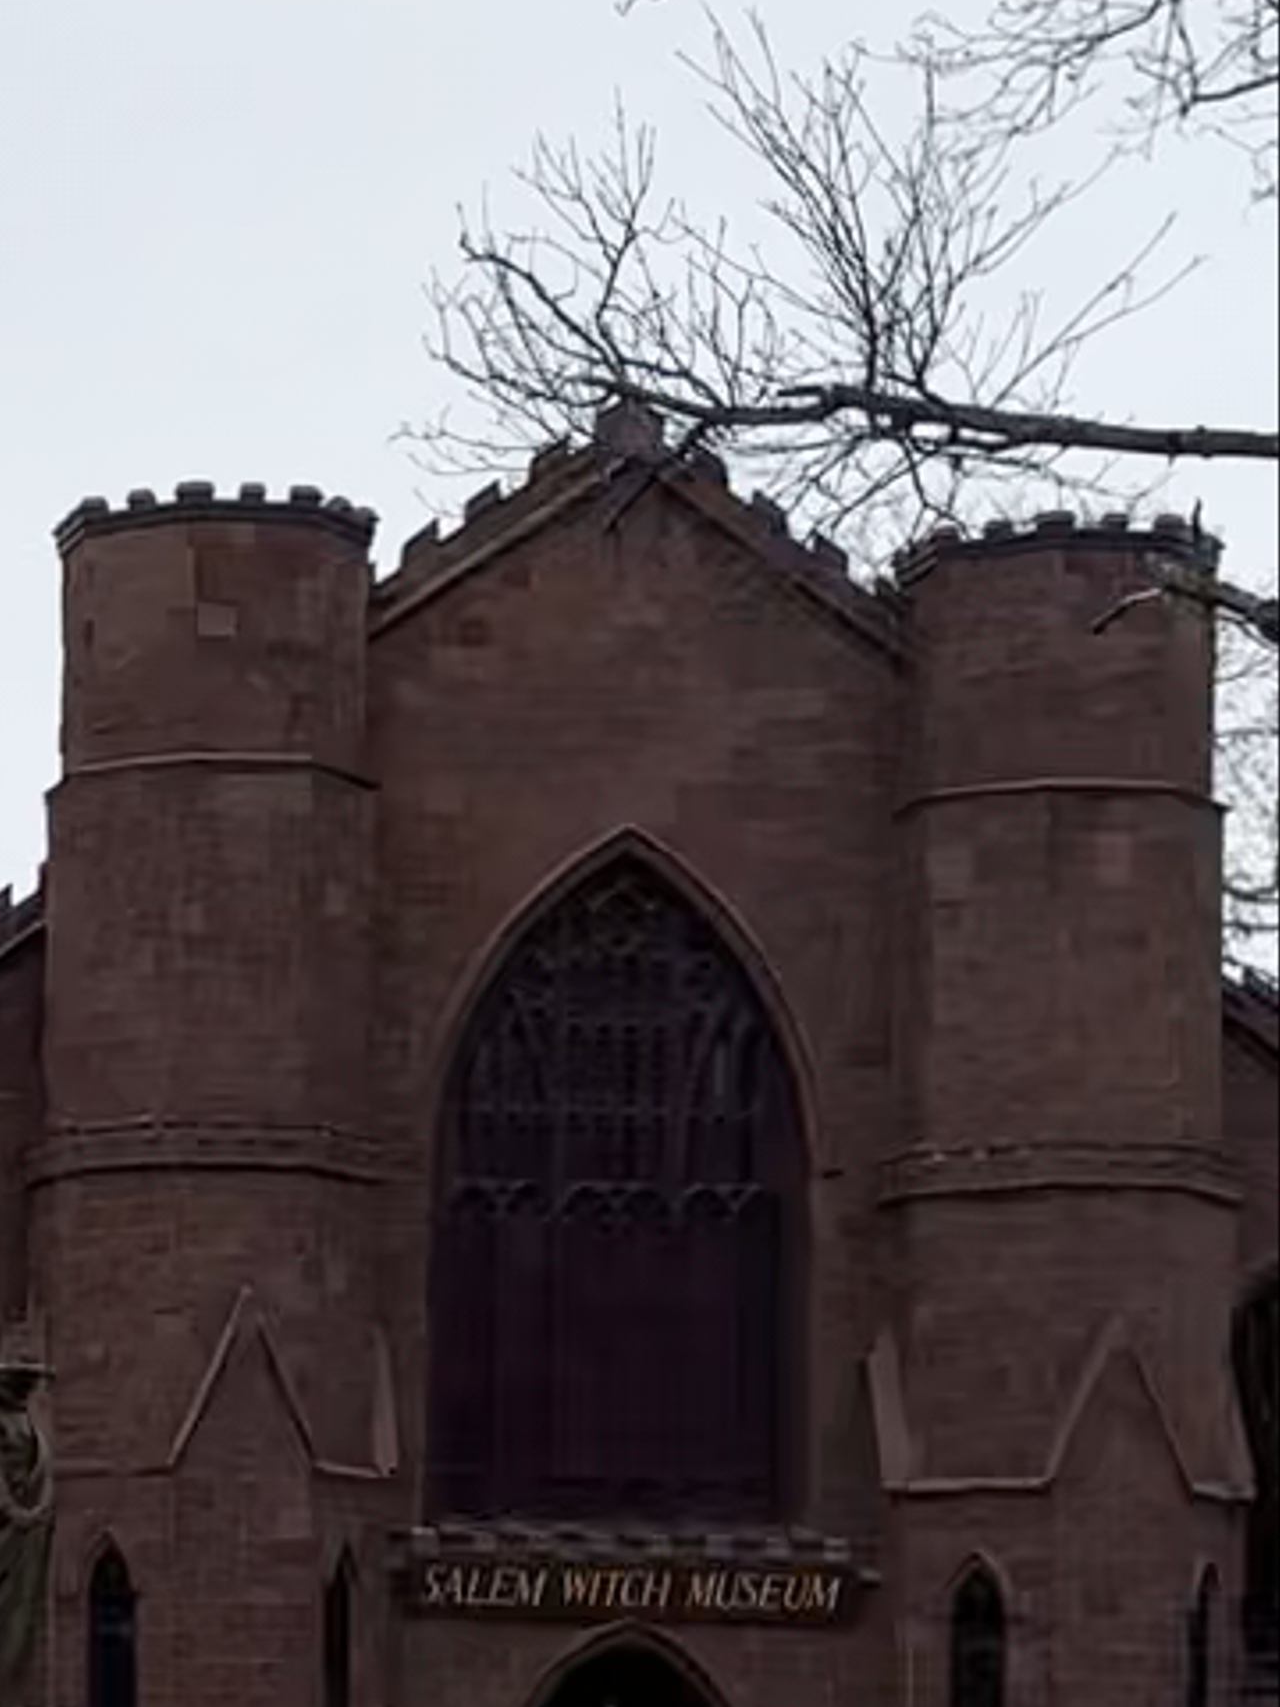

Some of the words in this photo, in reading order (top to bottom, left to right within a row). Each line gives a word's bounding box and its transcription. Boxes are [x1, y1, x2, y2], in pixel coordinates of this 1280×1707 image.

[425, 1564, 548, 1606] SALEM
[562, 1566, 672, 1608] WITCH
[684, 1568, 839, 1612] MUSEUM
